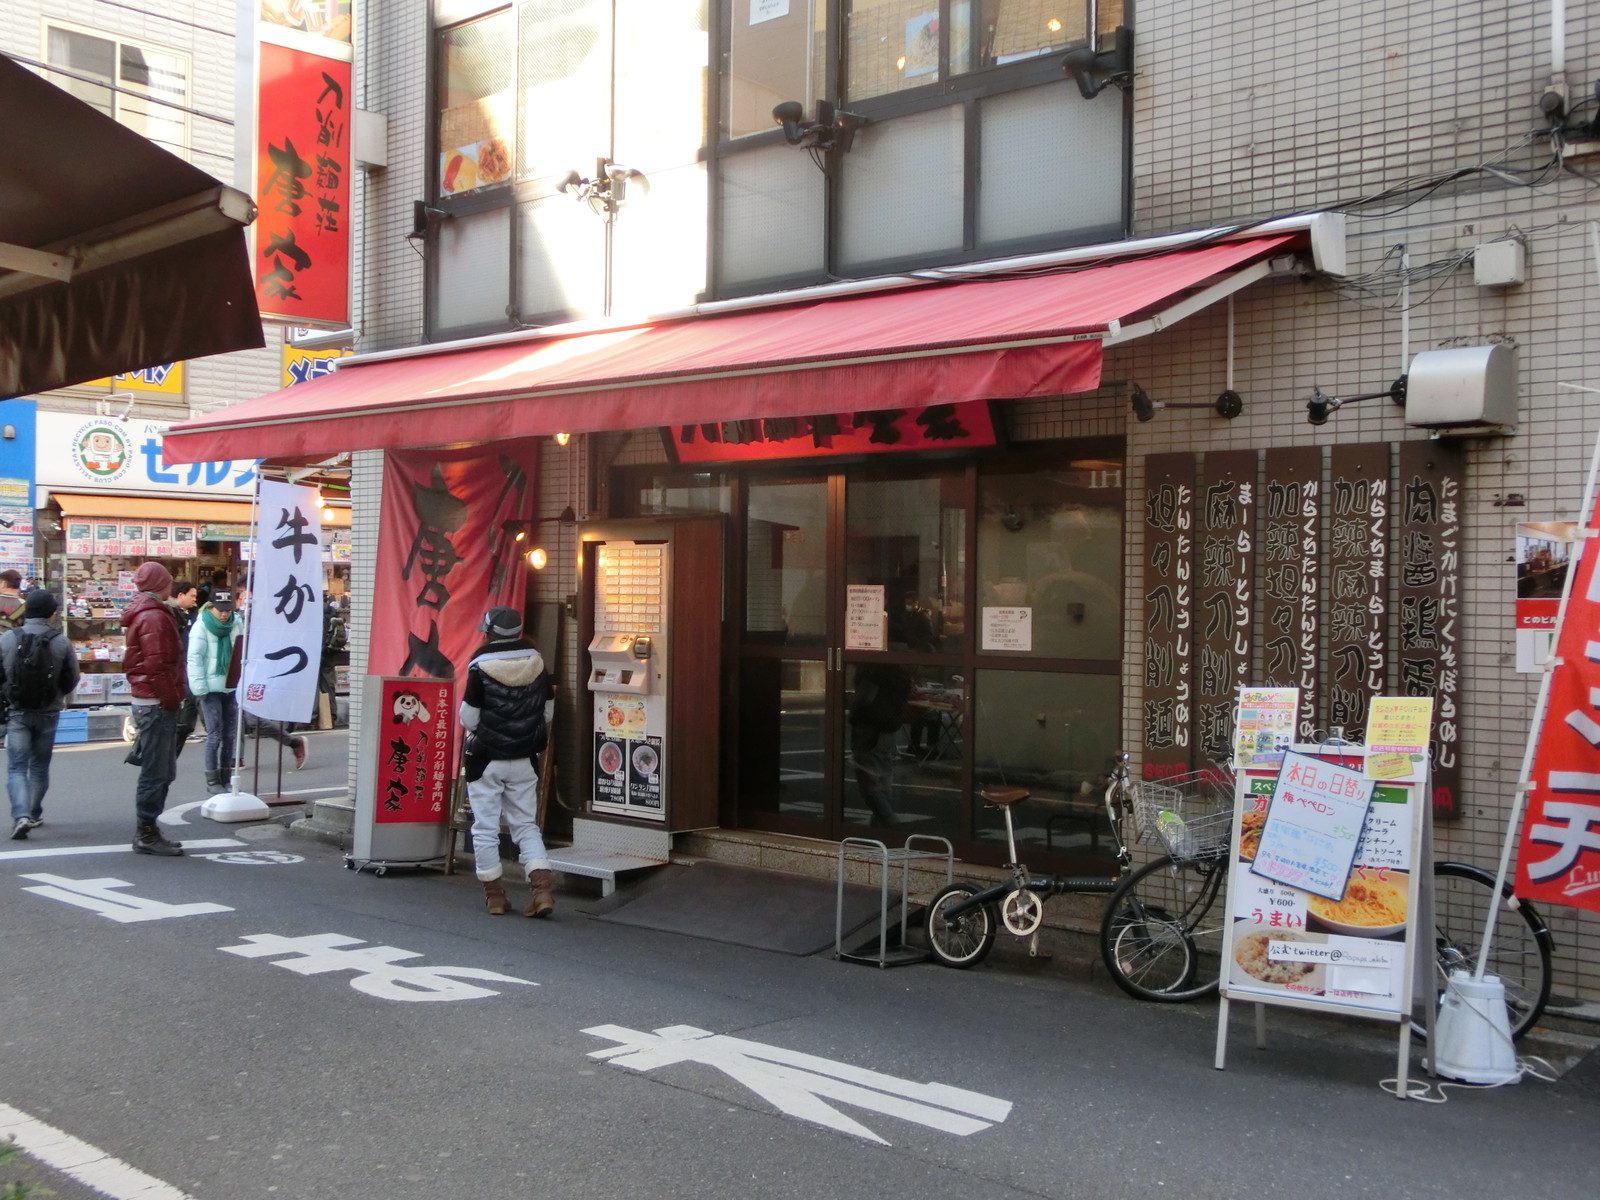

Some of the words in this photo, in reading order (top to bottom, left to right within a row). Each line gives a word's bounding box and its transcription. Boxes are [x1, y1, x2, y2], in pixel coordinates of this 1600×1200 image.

[264, 506, 318, 678] 牛かつ
[430, 688, 449, 813] 日本で最初の刀削麺専門店
[1251, 908, 1303, 929] うまい
